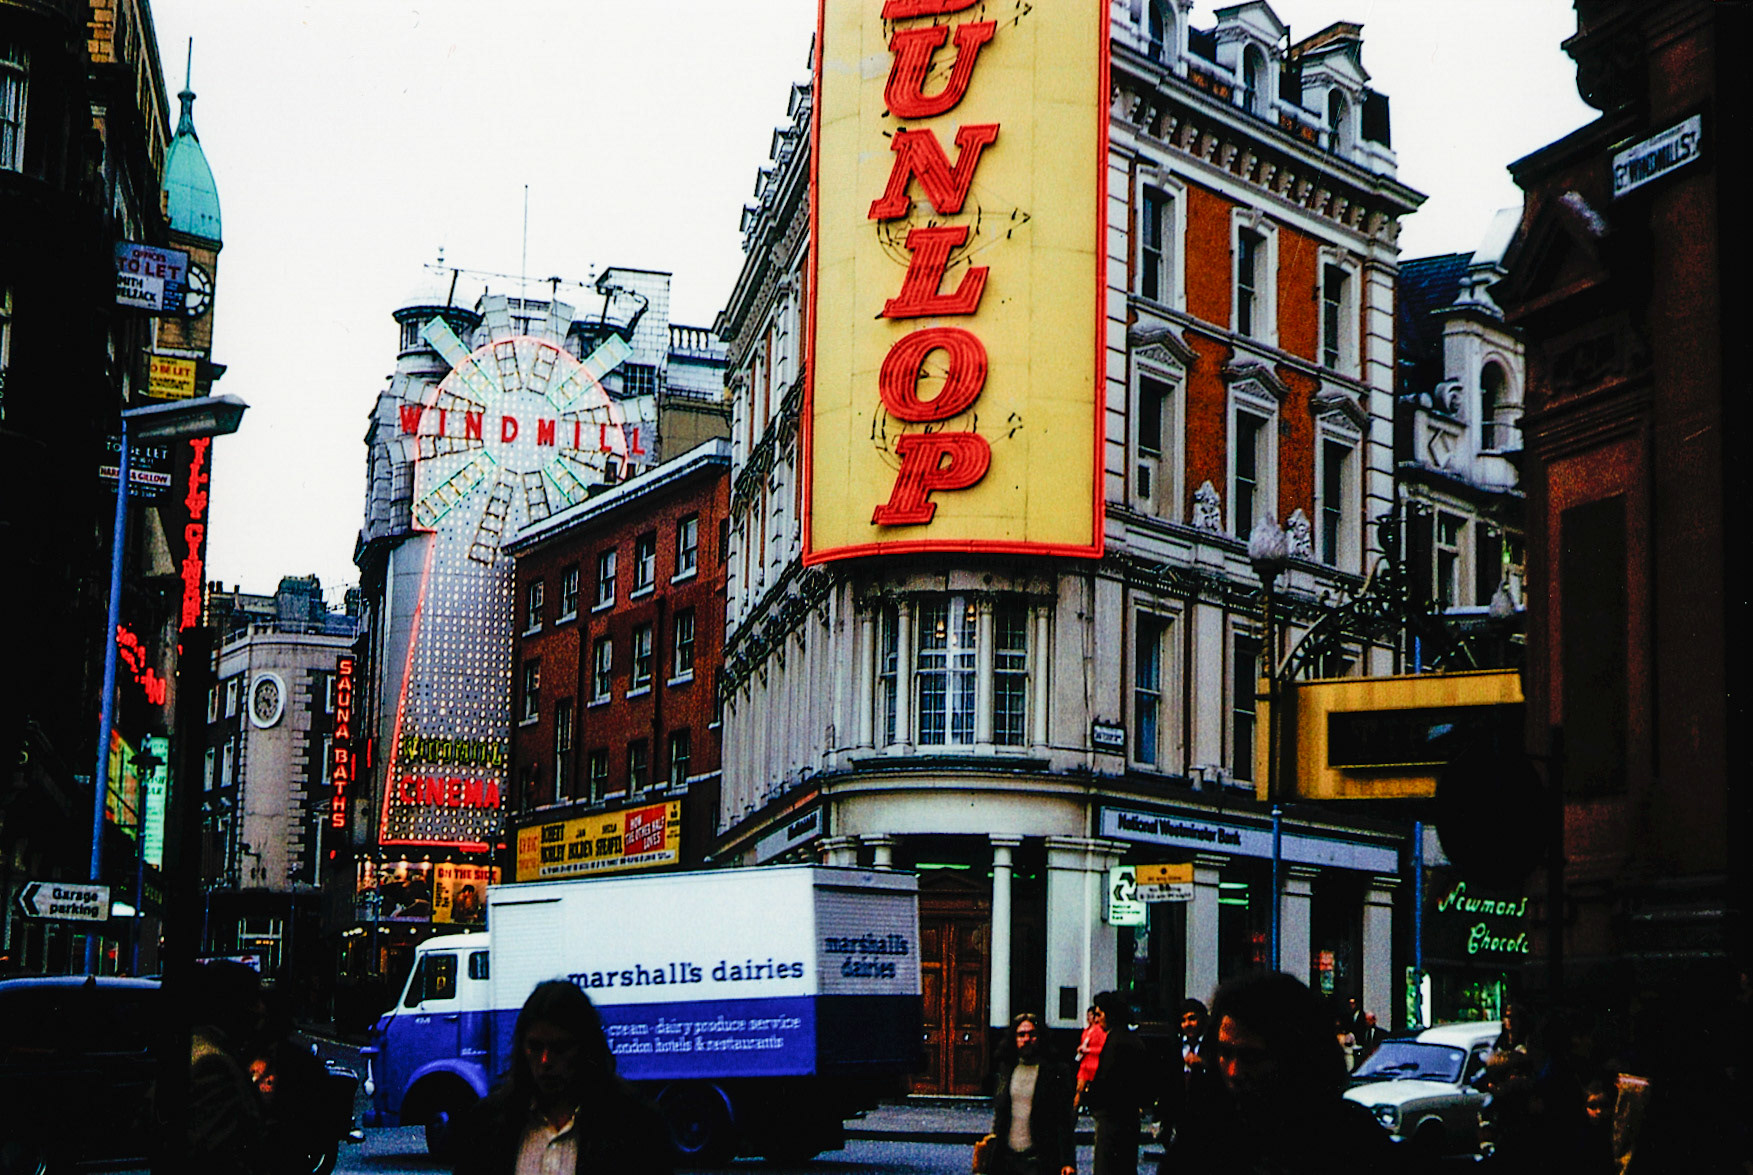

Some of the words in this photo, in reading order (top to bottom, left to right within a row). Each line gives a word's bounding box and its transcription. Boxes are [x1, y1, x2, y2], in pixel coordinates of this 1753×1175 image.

[118, 256, 140, 273] TO
[144, 261, 182, 280] LET
[868, 0, 1000, 526] UNLOP
[116, 274, 143, 289] MITH
[173, 367, 191, 377] LET
[398, 404, 645, 455] WINDMILL
[105, 440, 122, 453] TO
[145, 446, 169, 460] LET
[334, 659, 353, 740] SAUNA
[331, 748, 349, 828] BATHS
[398, 774, 500, 809] CINEMA
[1118, 812, 1158, 835] National
[1159, 818, 1217, 843] Westminster
[1217, 827, 1242, 846] Bank
[454, 868, 472, 880] THE
[52, 888, 98, 903] Garage
[50, 902, 99, 918] parking
[568, 962, 703, 989] marshall's
[711, 958, 804, 983] dairies
[841, 956, 896, 979] dairies
[654, 1017, 694, 1036] dairy
[693, 1014, 747, 1036] produce
[748, 1014, 802, 1032] service
[607, 1037, 654, 1055] London
[654, 1036, 693, 1053] hotels
[704, 1034, 785, 1052] restaurants
